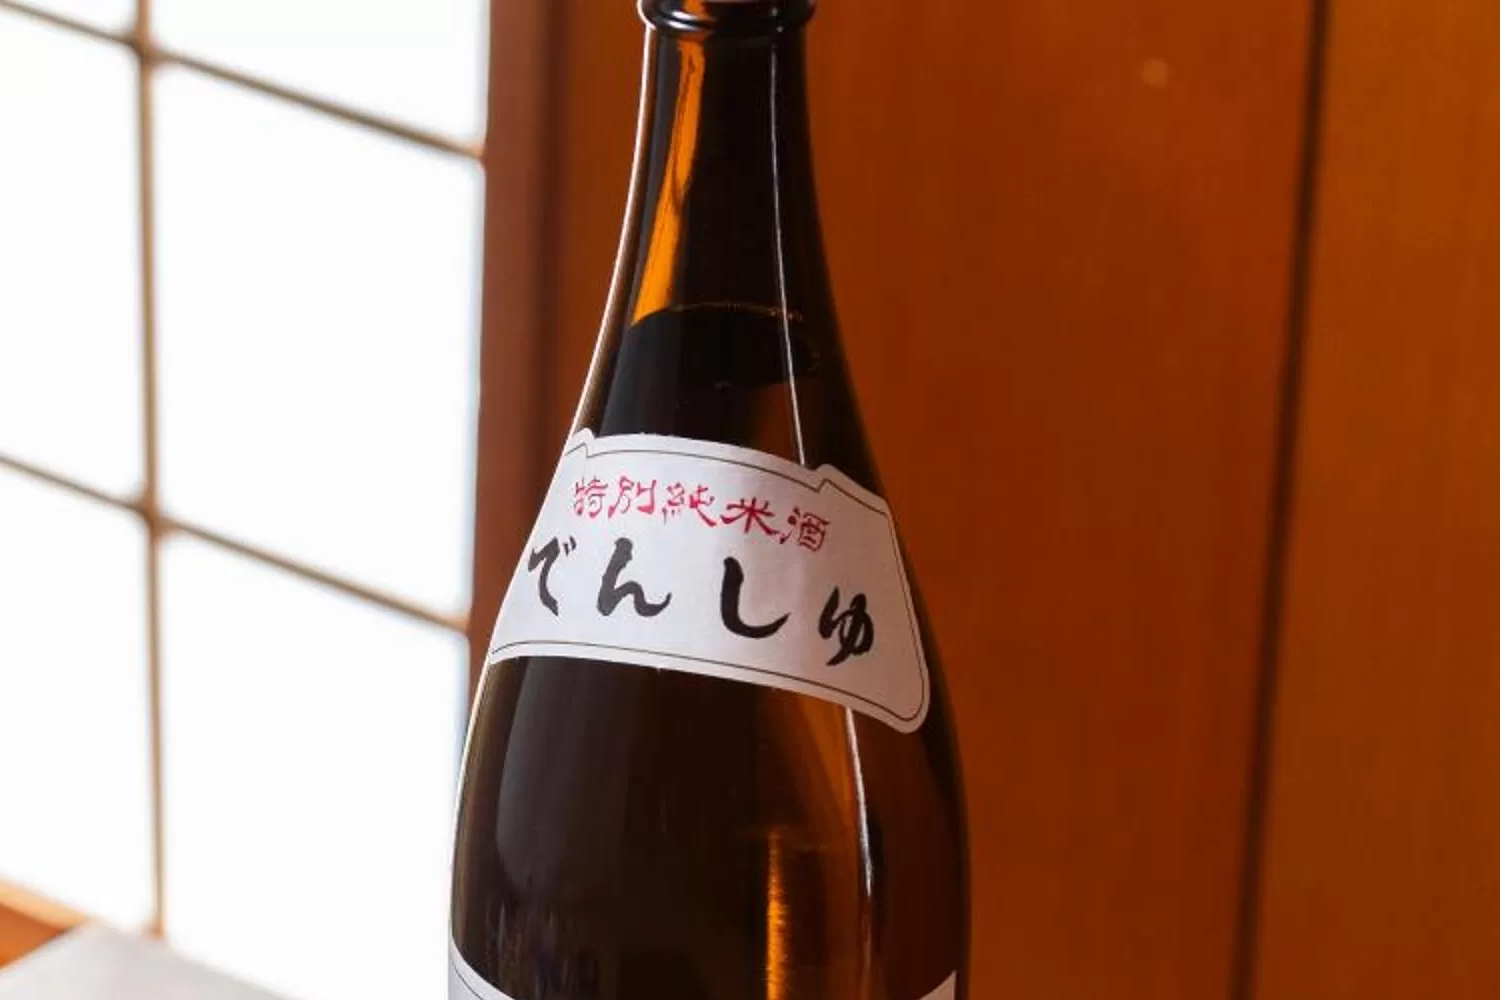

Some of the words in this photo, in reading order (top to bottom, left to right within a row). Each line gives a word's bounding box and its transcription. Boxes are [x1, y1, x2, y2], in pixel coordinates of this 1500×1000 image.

[573, 475, 830, 553] 特別純米酒
[527, 536, 876, 667] でんしゅ
